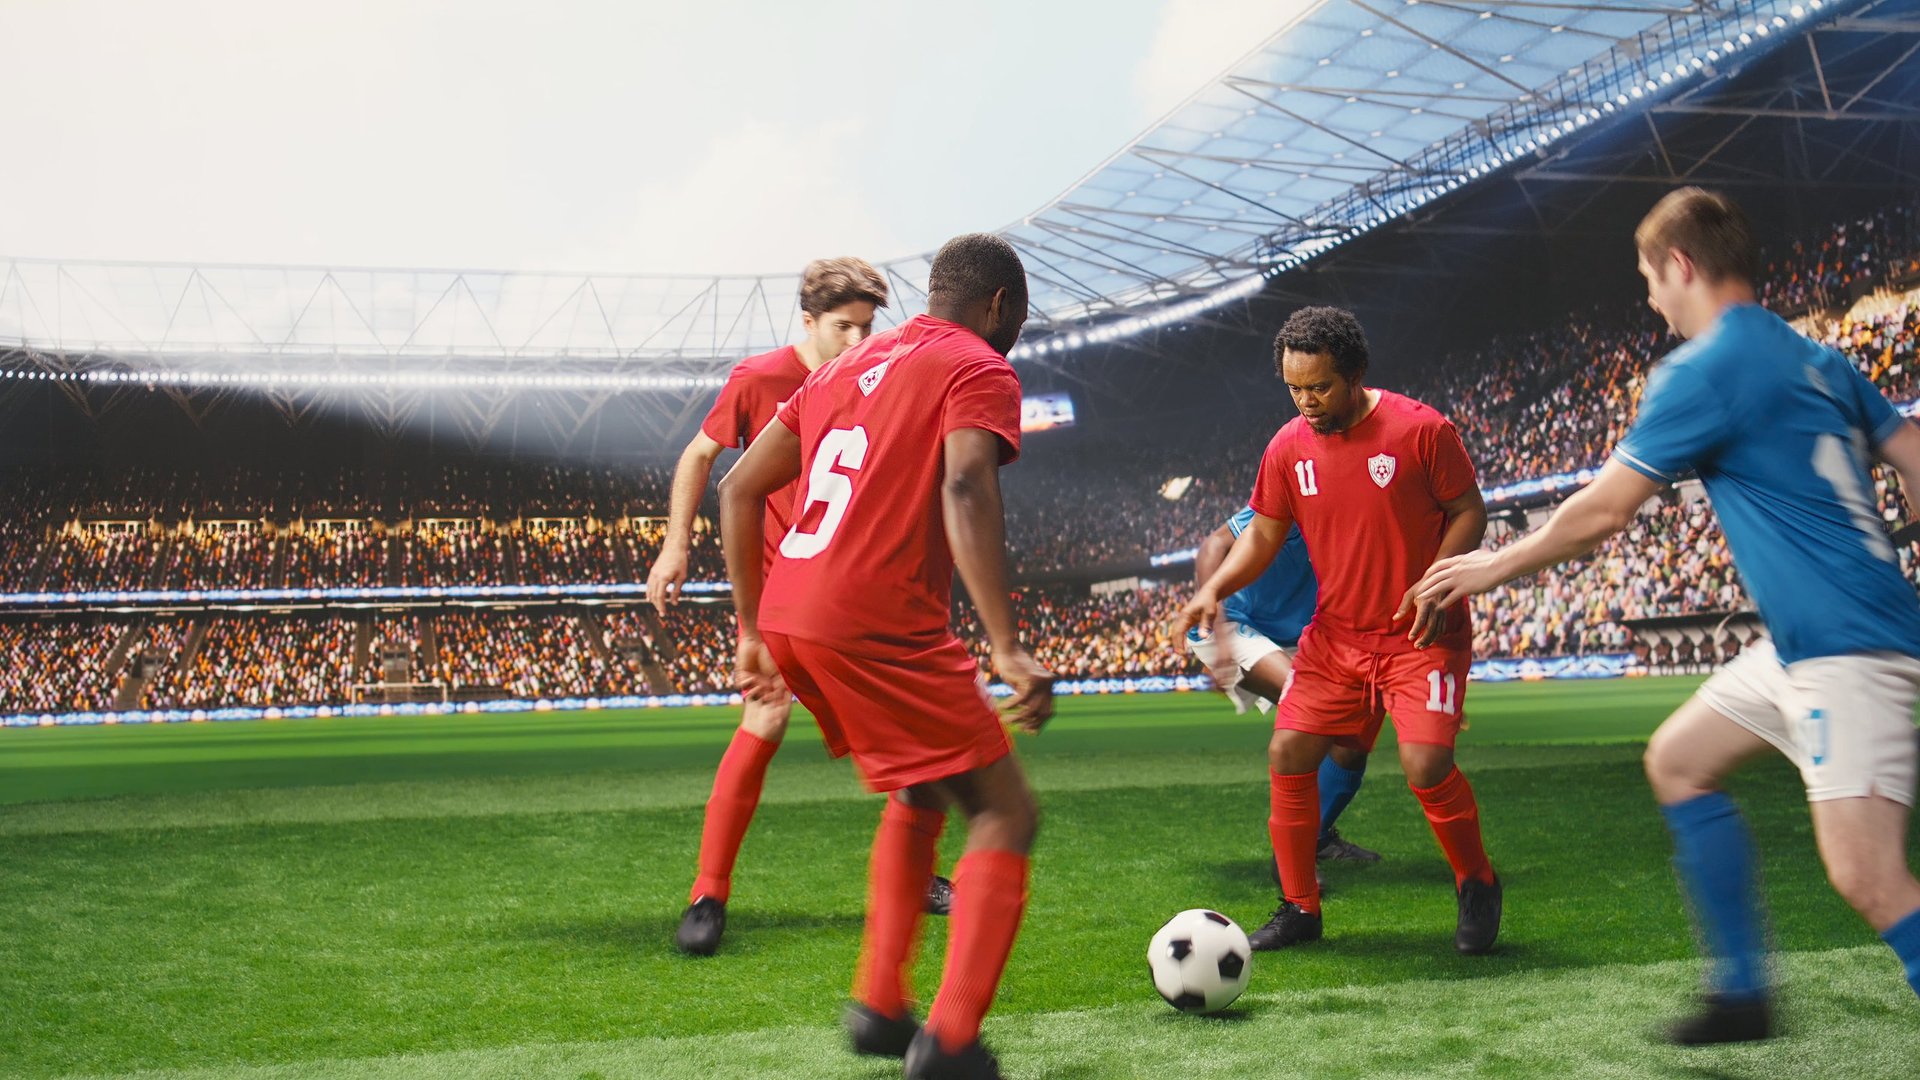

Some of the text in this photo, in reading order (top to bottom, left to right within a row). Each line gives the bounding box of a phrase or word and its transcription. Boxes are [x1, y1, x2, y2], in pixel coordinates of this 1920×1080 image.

[779, 425, 869, 559] 6
[1294, 459, 1318, 496] 11
[1426, 669, 1455, 715] 11
